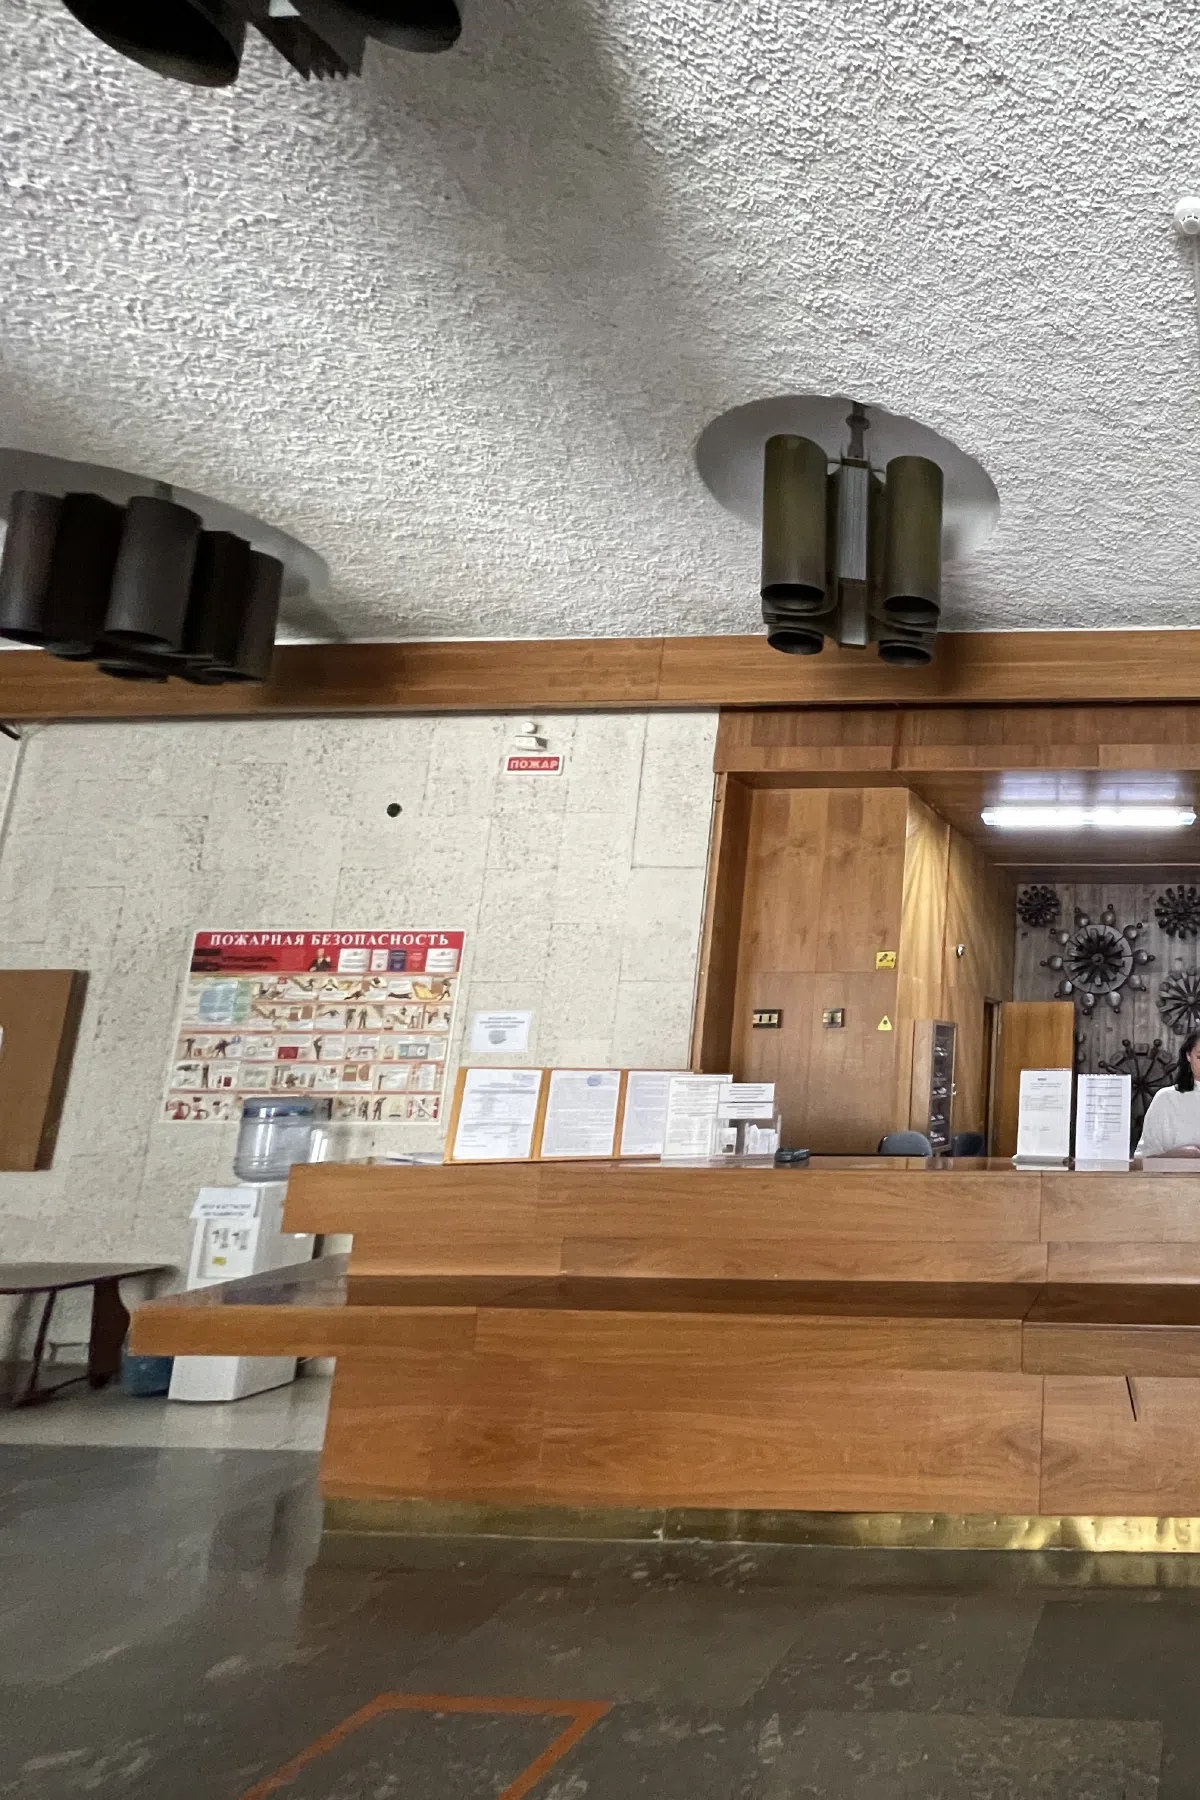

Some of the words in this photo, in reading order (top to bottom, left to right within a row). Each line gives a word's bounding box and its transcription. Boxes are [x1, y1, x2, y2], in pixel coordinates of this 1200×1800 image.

[510, 760, 558, 769] ПОЖАР
[210, 934, 305, 946] ПОЖАРНАЯ
[311, 934, 449, 946] БЕЗОПАСНОСТЬ
